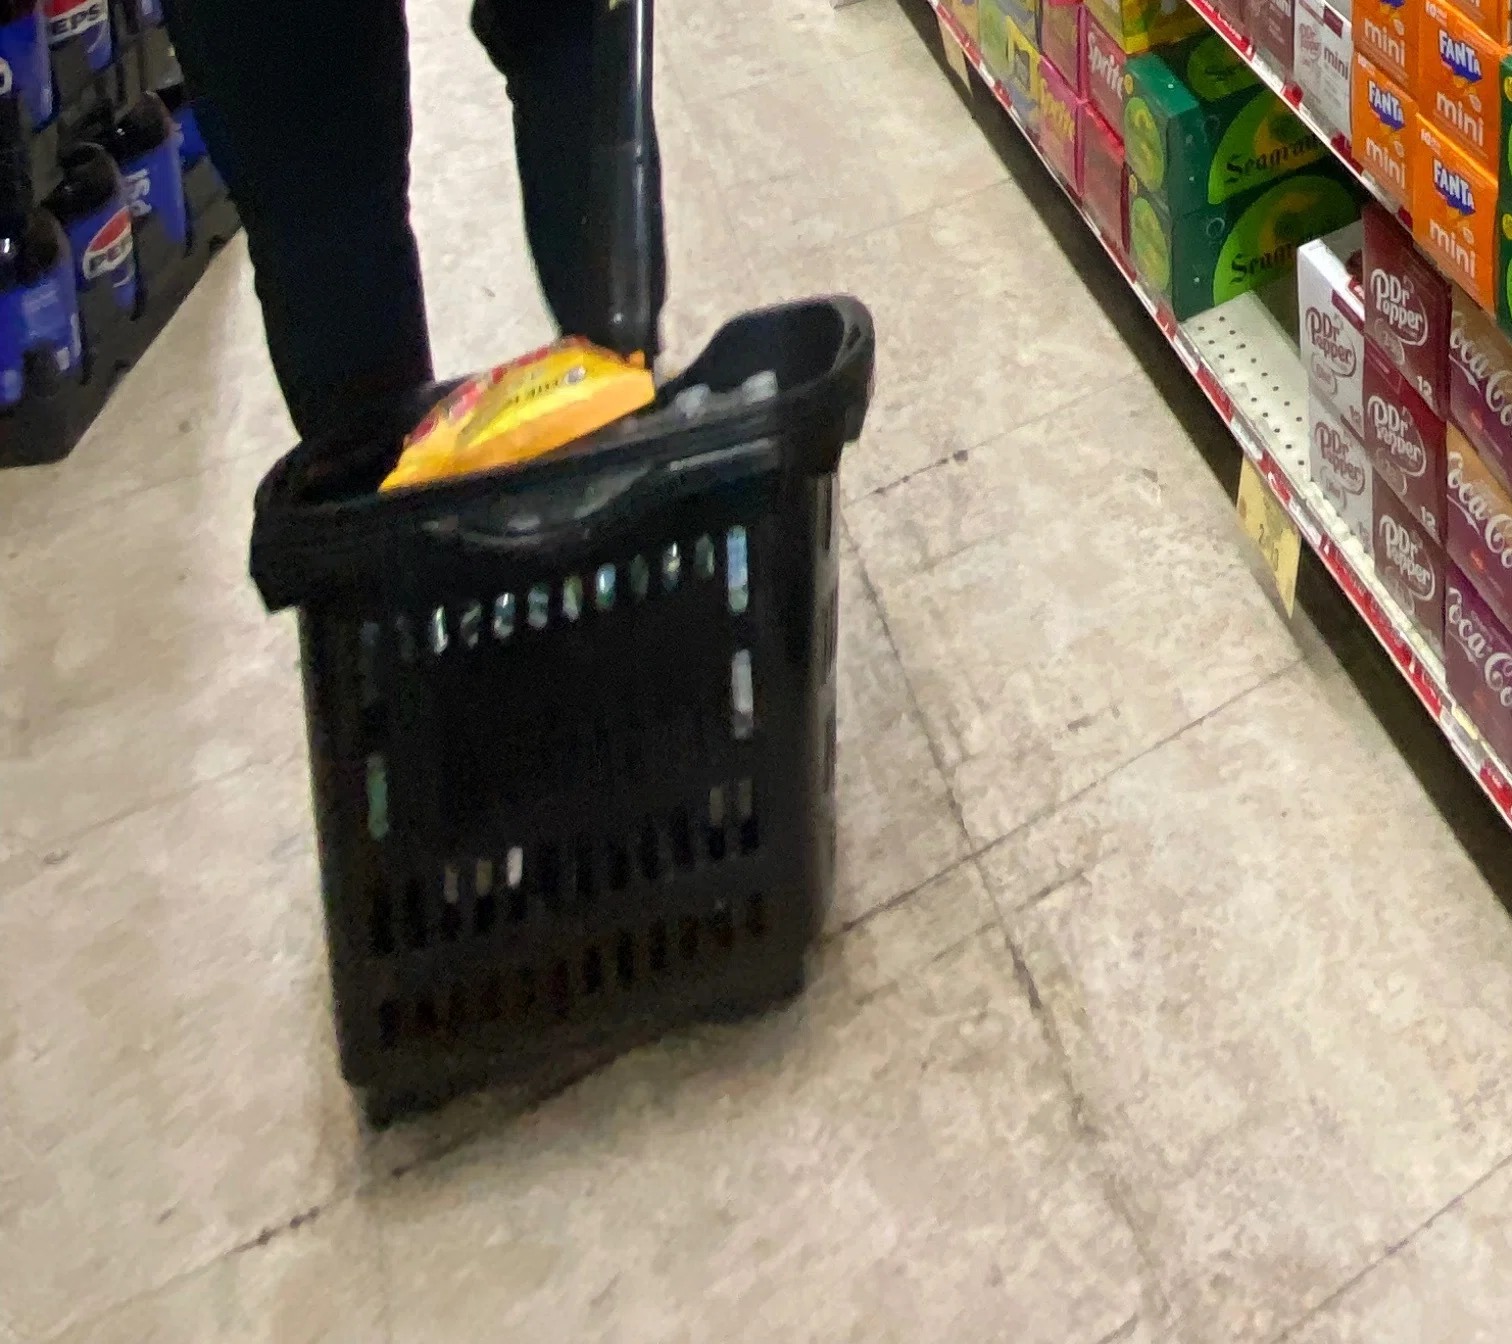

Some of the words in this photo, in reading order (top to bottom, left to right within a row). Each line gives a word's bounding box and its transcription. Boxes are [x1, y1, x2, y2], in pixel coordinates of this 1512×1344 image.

[1364, 16, 1406, 69] mini
[1438, 28, 1483, 76] FANTA
[1367, 80, 1405, 124] FANTA
[1435, 88, 1485, 148] mini
[1365, 136, 1406, 192] mini
[1433, 158, 1476, 210] FANTA
[1428, 218, 1477, 280] mini
